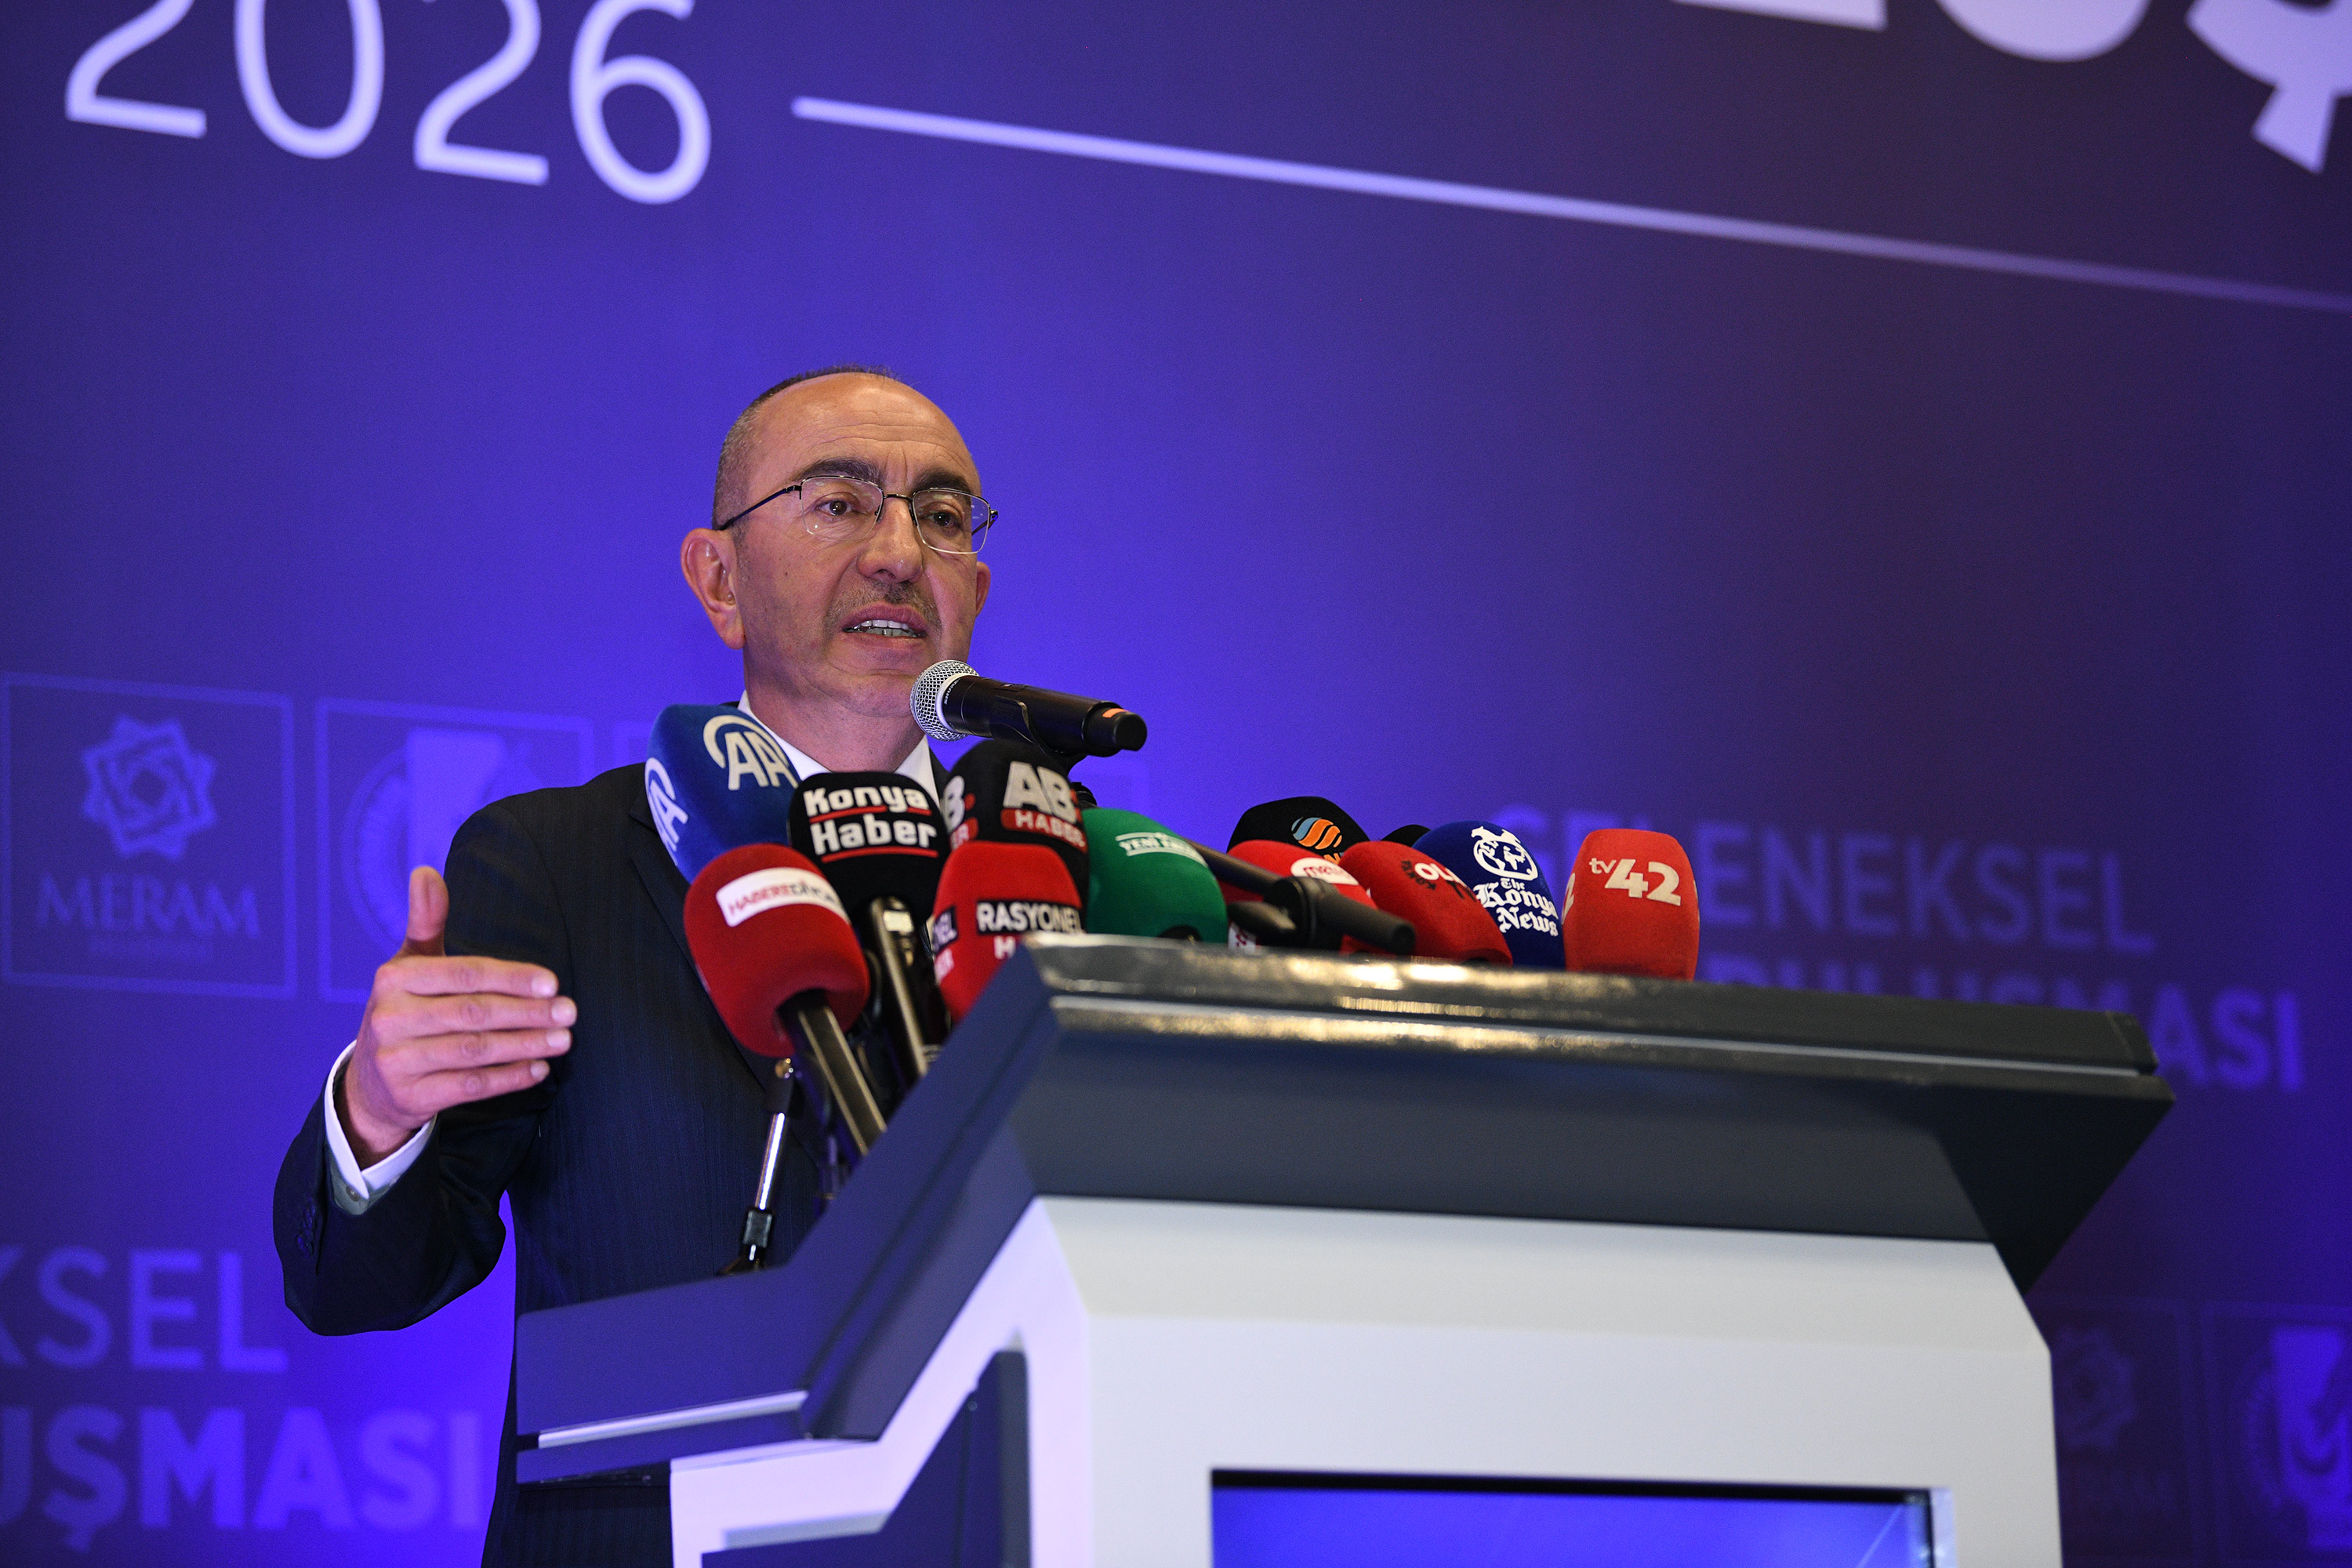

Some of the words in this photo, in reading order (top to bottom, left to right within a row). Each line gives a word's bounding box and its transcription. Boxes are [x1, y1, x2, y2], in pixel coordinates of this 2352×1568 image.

[65, 0, 711, 204] 2026
[724, 731, 798, 791] AA
[803, 785, 931, 818] Konya
[1003, 760, 1078, 824] AB
[810, 813, 938, 856] Haber
[1014, 809, 1087, 848] HABER
[1472, 881, 1559, 920] Konya
[1490, 802, 2156, 956] ENEKSEL
[1500, 878, 1525, 891] The
[35, 870, 261, 940] MERAM
[1496, 906, 1559, 937] News
